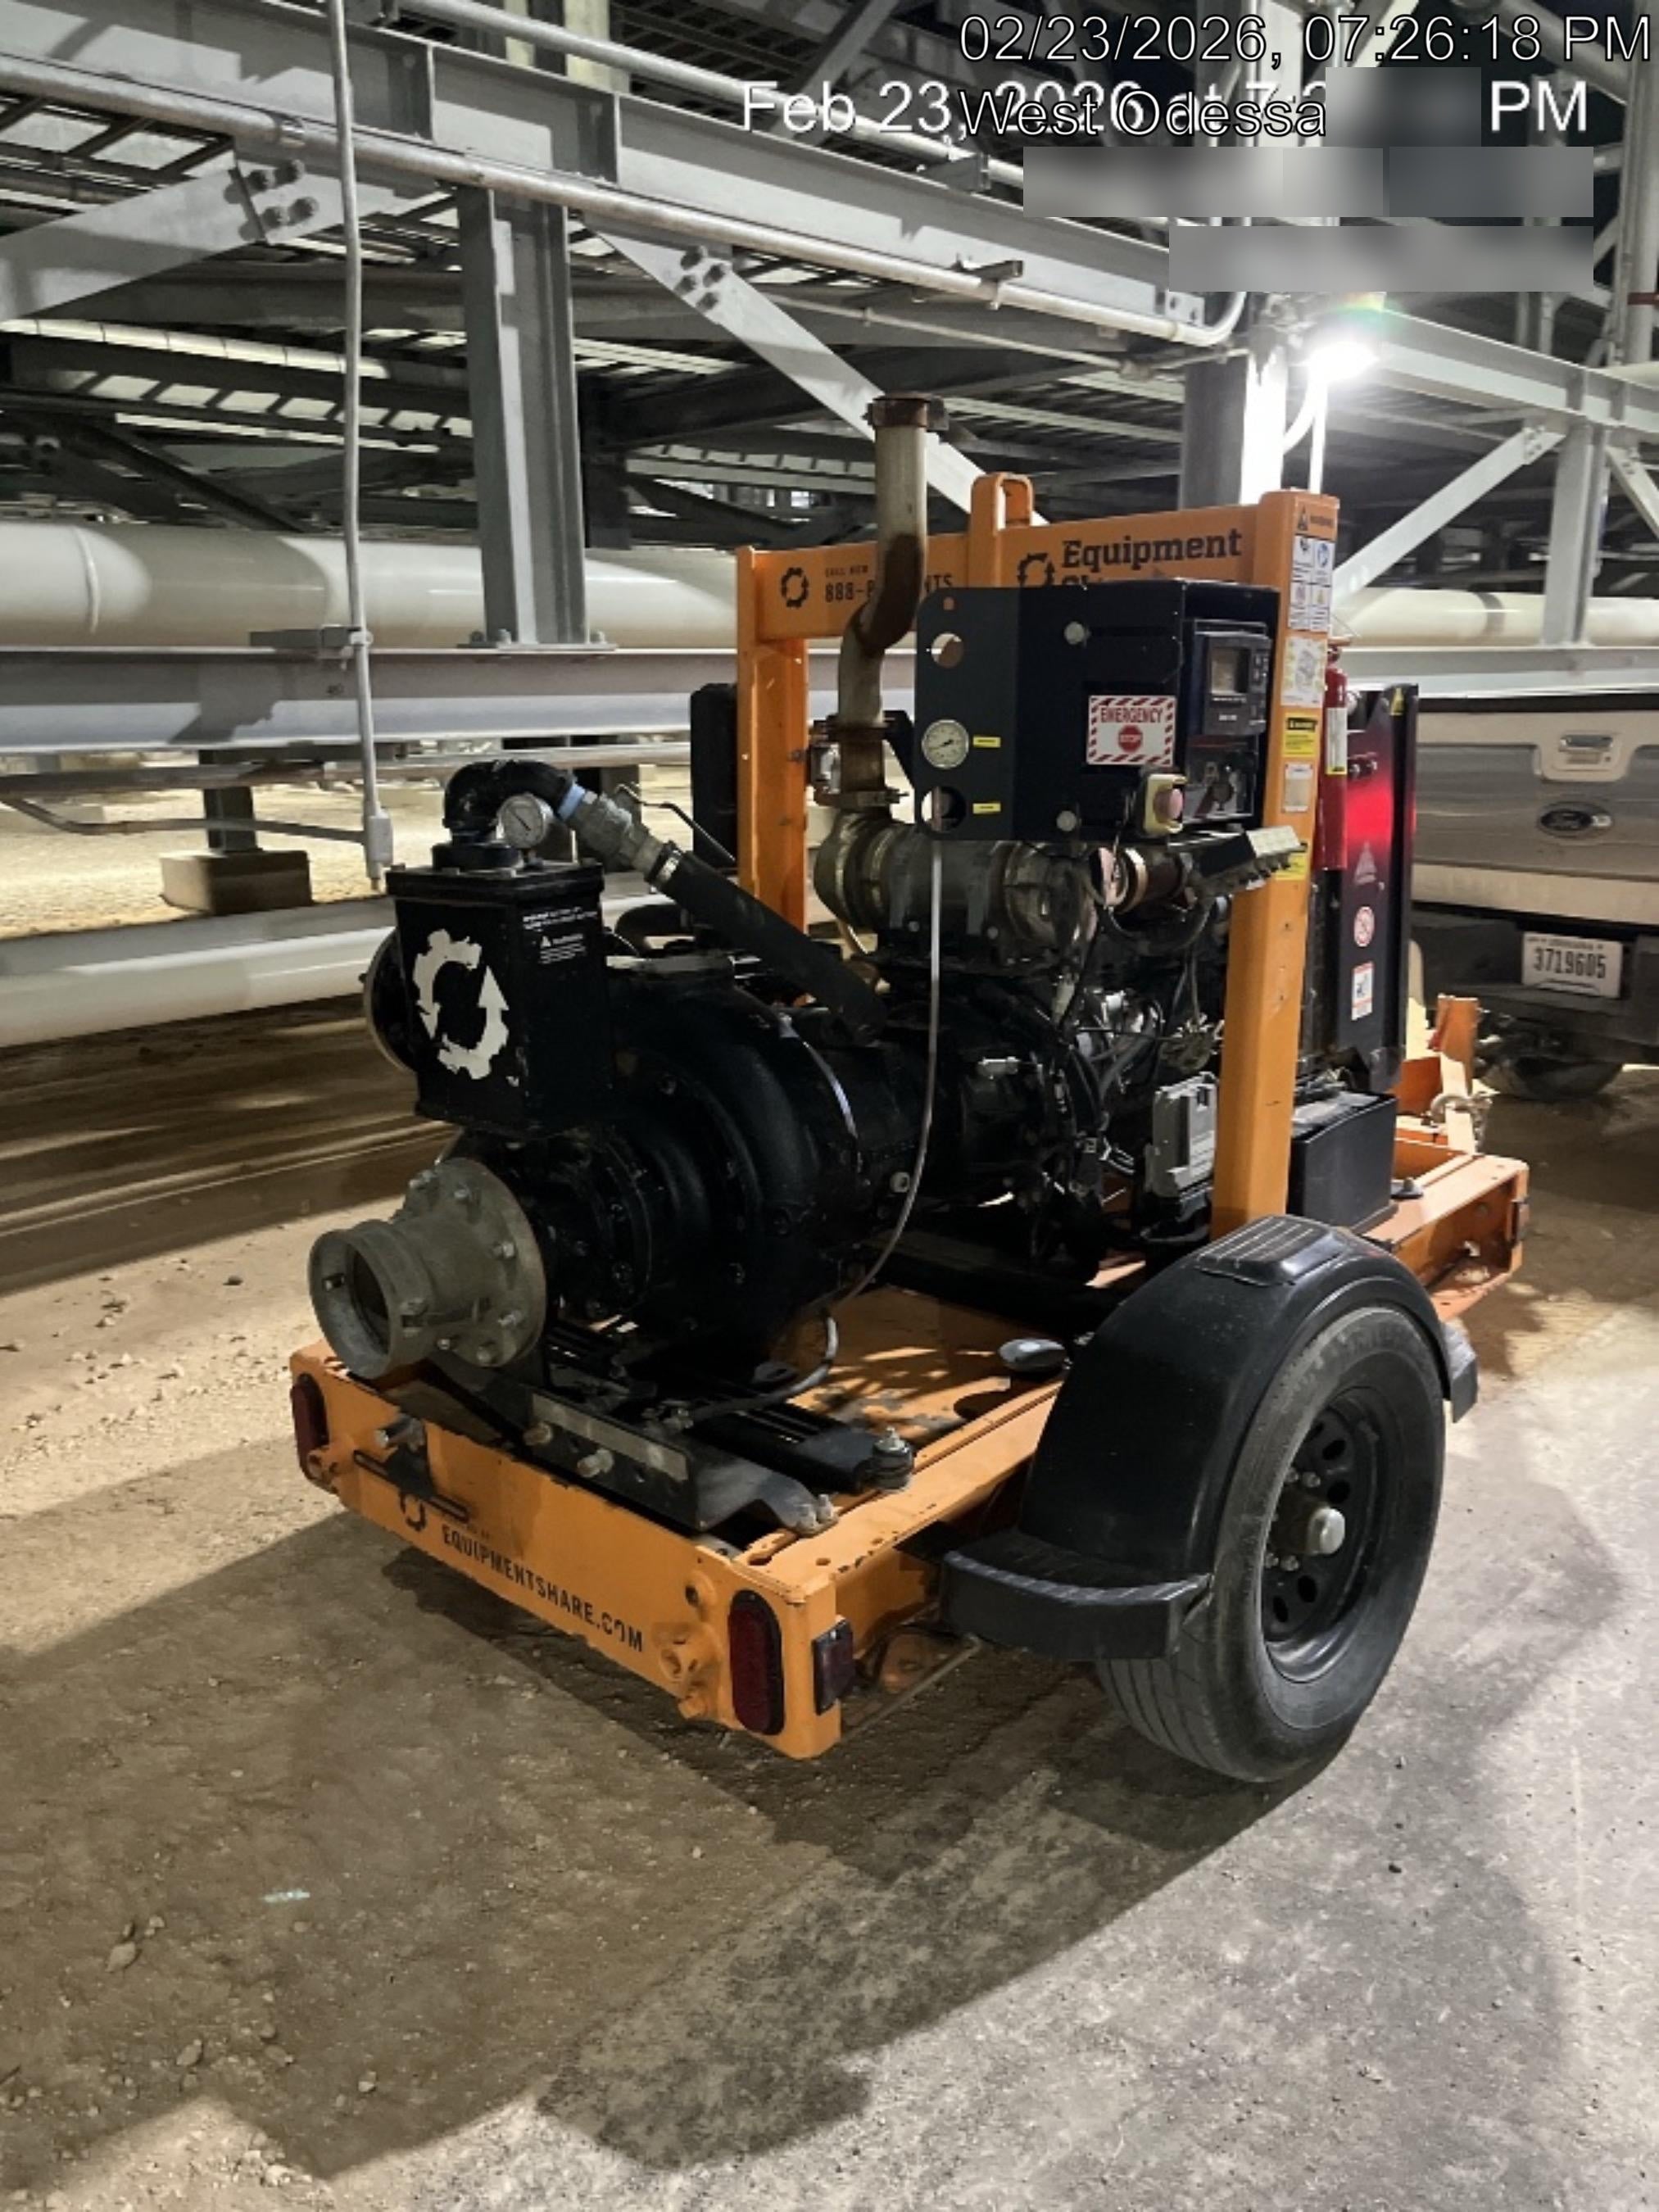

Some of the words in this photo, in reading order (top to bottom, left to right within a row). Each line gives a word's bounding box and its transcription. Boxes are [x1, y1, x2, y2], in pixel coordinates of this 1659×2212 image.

[1062, 528, 1243, 573] Equipment
[1100, 707, 1163, 723] EMERGENCY
[1533, 945, 1607, 980] 3719605
[442, 1523, 644, 1653] EQUIPMENTSHARE.COM
